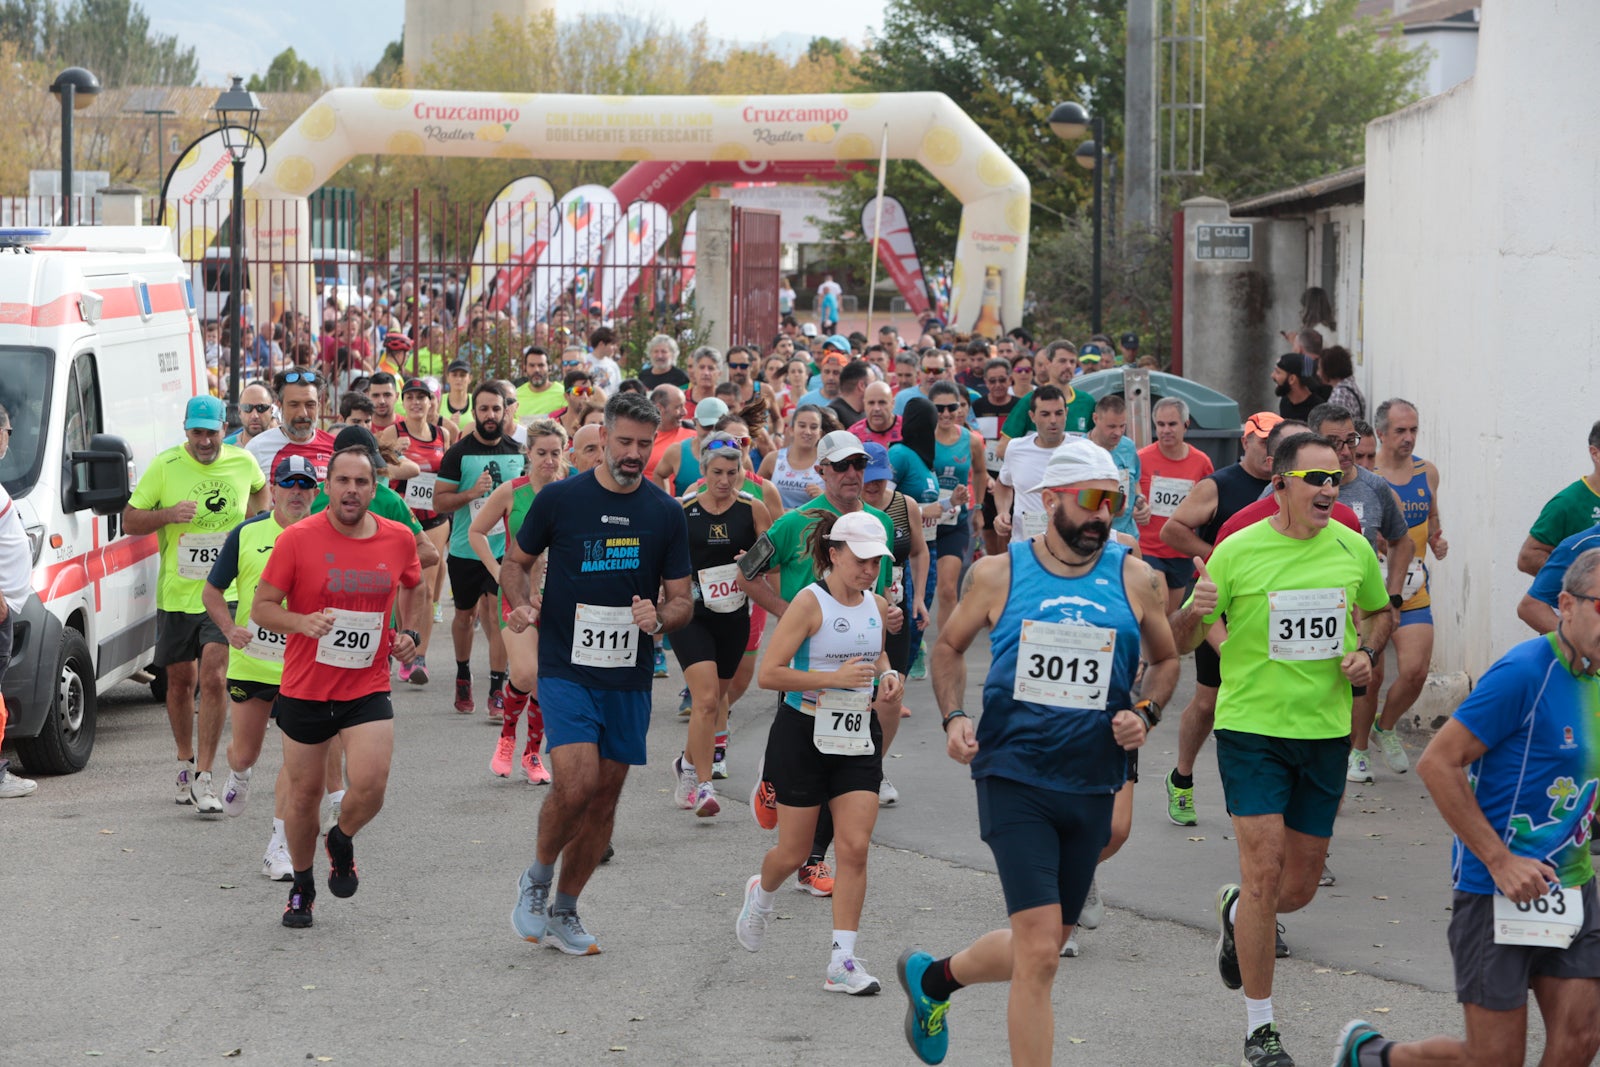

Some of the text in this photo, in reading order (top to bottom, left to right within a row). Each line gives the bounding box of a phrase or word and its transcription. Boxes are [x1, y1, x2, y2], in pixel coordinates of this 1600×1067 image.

[414, 102, 520, 123] Cruzcampo
[742, 105, 848, 124] Cruzcampo
[424, 124, 475, 143] Radler
[545, 128, 713, 143] DOBLEMENTE REFRESCANTE
[753, 128, 804, 146] Radler
[1214, 227, 1246, 237] CALLE
[189, 548, 219, 563] 783
[584, 537, 640, 560] 16 MEMORIAL
[606, 547, 640, 559] PADRE
[581, 558, 640, 573] MARCELINO
[1279, 617, 1337, 640] 3150
[333, 630, 370, 649] 290
[582, 629, 630, 649] 3111
[1028, 654, 1099, 684] 3013
[831, 712, 862, 732] 768
